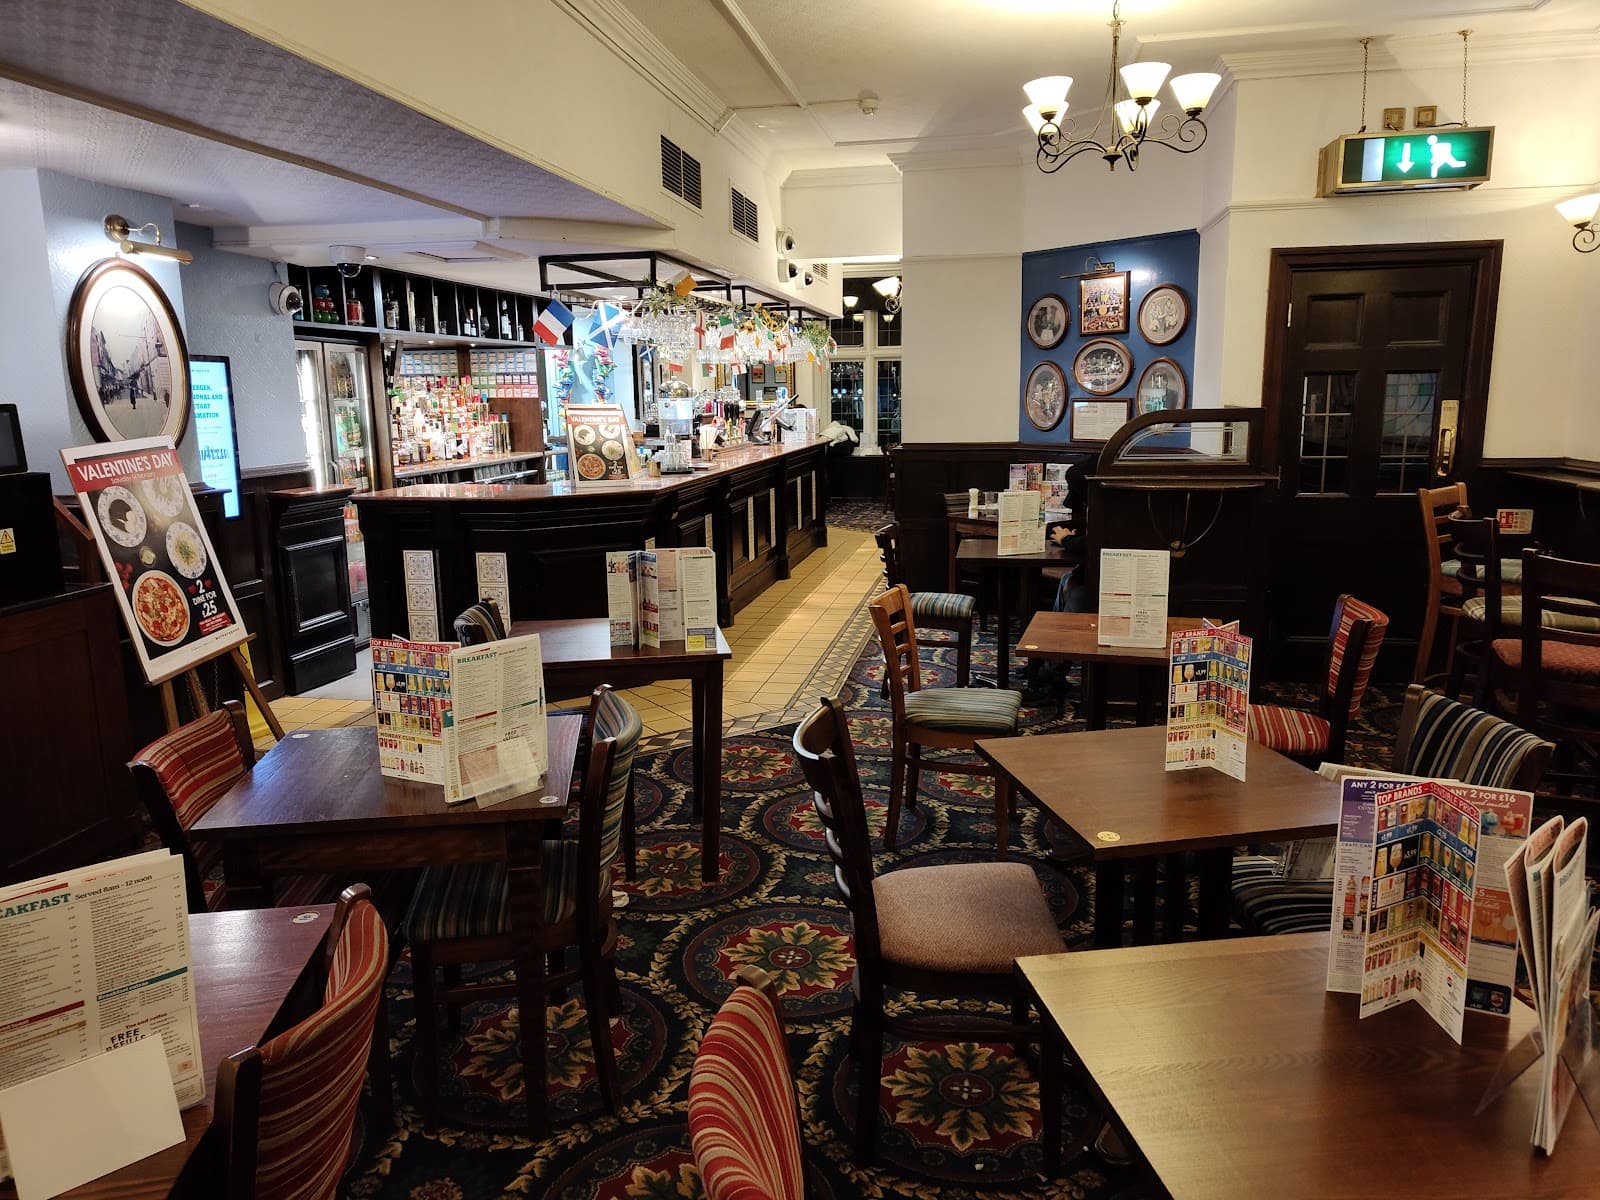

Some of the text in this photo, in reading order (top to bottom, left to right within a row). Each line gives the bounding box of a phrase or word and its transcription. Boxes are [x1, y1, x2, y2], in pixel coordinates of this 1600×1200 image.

[77, 452, 174, 482] VALENTINE'S DAY
[196, 580, 205, 594] 2
[206, 590, 217, 600] FOR
[202, 600, 218, 618] £25
[1370, 781, 1376, 789] 2
[1377, 794, 1392, 805] TOP
[1394, 786, 1422, 800] BRANDS
[1430, 783, 1457, 805] SENSIBLE
[1470, 790, 1477, 798] 2
[1499, 794, 1516, 803] £16
[75, 888, 102, 900] Served
[103, 884, 120, 893] 8am
[134, 875, 153, 884] noon
[1368, 932, 1418, 953] MONDAY CLUB
[110, 1028, 140, 1044] FREE
